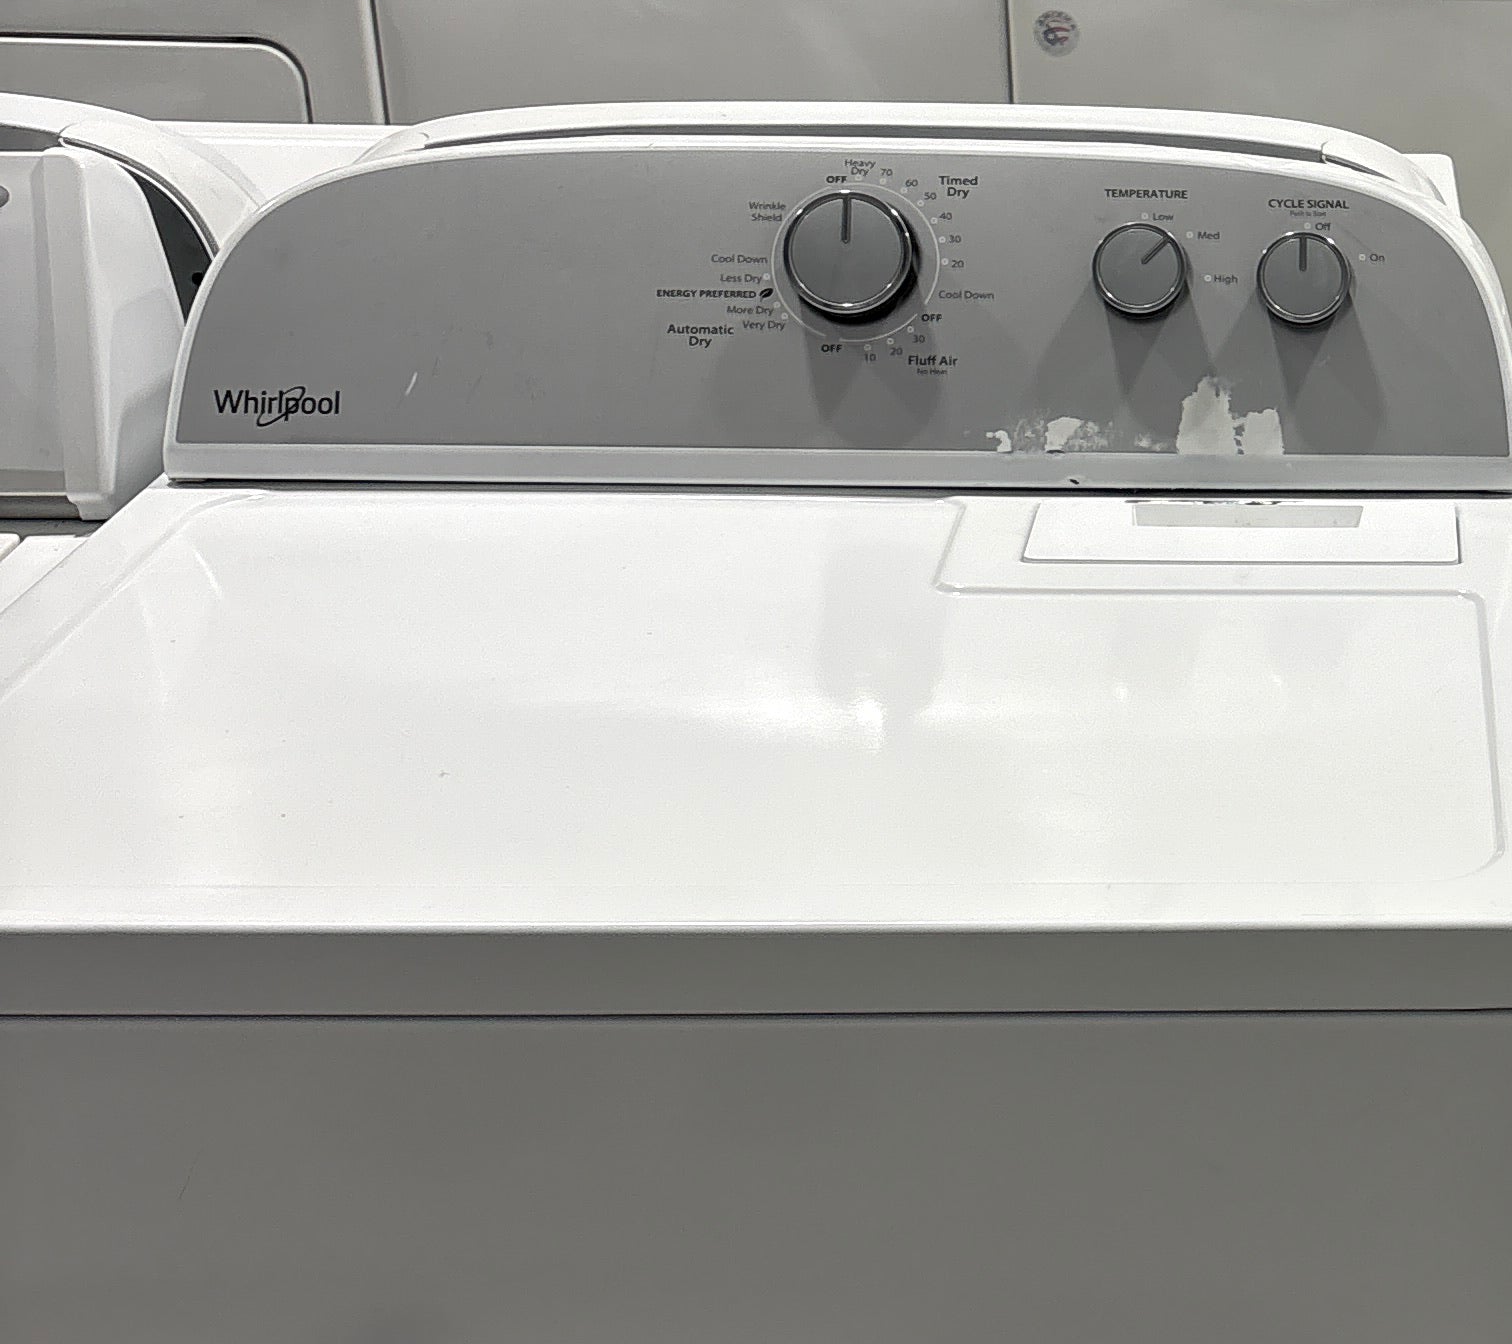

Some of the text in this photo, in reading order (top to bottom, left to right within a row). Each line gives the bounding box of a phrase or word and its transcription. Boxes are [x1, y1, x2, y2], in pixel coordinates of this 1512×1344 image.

[880, 168, 893, 177] 70
[826, 175, 847, 184] OFF
[905, 179, 918, 187] 60
[938, 175, 978, 186] Timed
[924, 192, 937, 200] 50
[946, 187, 970, 199] Dry
[1104, 188, 1188, 200] TEMPERATURE
[749, 201, 786, 211] Wrinkle
[1268, 199, 1350, 210] CYCLE SIGNAL
[751, 213, 783, 223] Shield
[1152, 212, 1174, 221] Low
[1315, 222, 1331, 231] Off
[1197, 231, 1220, 240] Med
[711, 254, 767, 264] Cool Down
[1369, 254, 1385, 263] On
[951, 260, 964, 268] 20
[720, 274, 763, 285] Less Dry
[1214, 274, 1238, 285] High
[656, 289, 757, 299] ENERGY PREFERRED
[938, 290, 995, 300] Cool Down
[726, 304, 774, 317] More Dry
[921, 313, 942, 323] OFF
[666, 324, 735, 336] Automatic
[742, 320, 786, 332] Very Dry
[688, 336, 712, 349] Dry
[912, 335, 925, 344] 30
[821, 344, 843, 353] OFF
[889, 347, 903, 356] 20
[864, 353, 877, 362] 10
[908, 354, 958, 366] Fluff Air
[213, 386, 341, 424] Whirlpool
